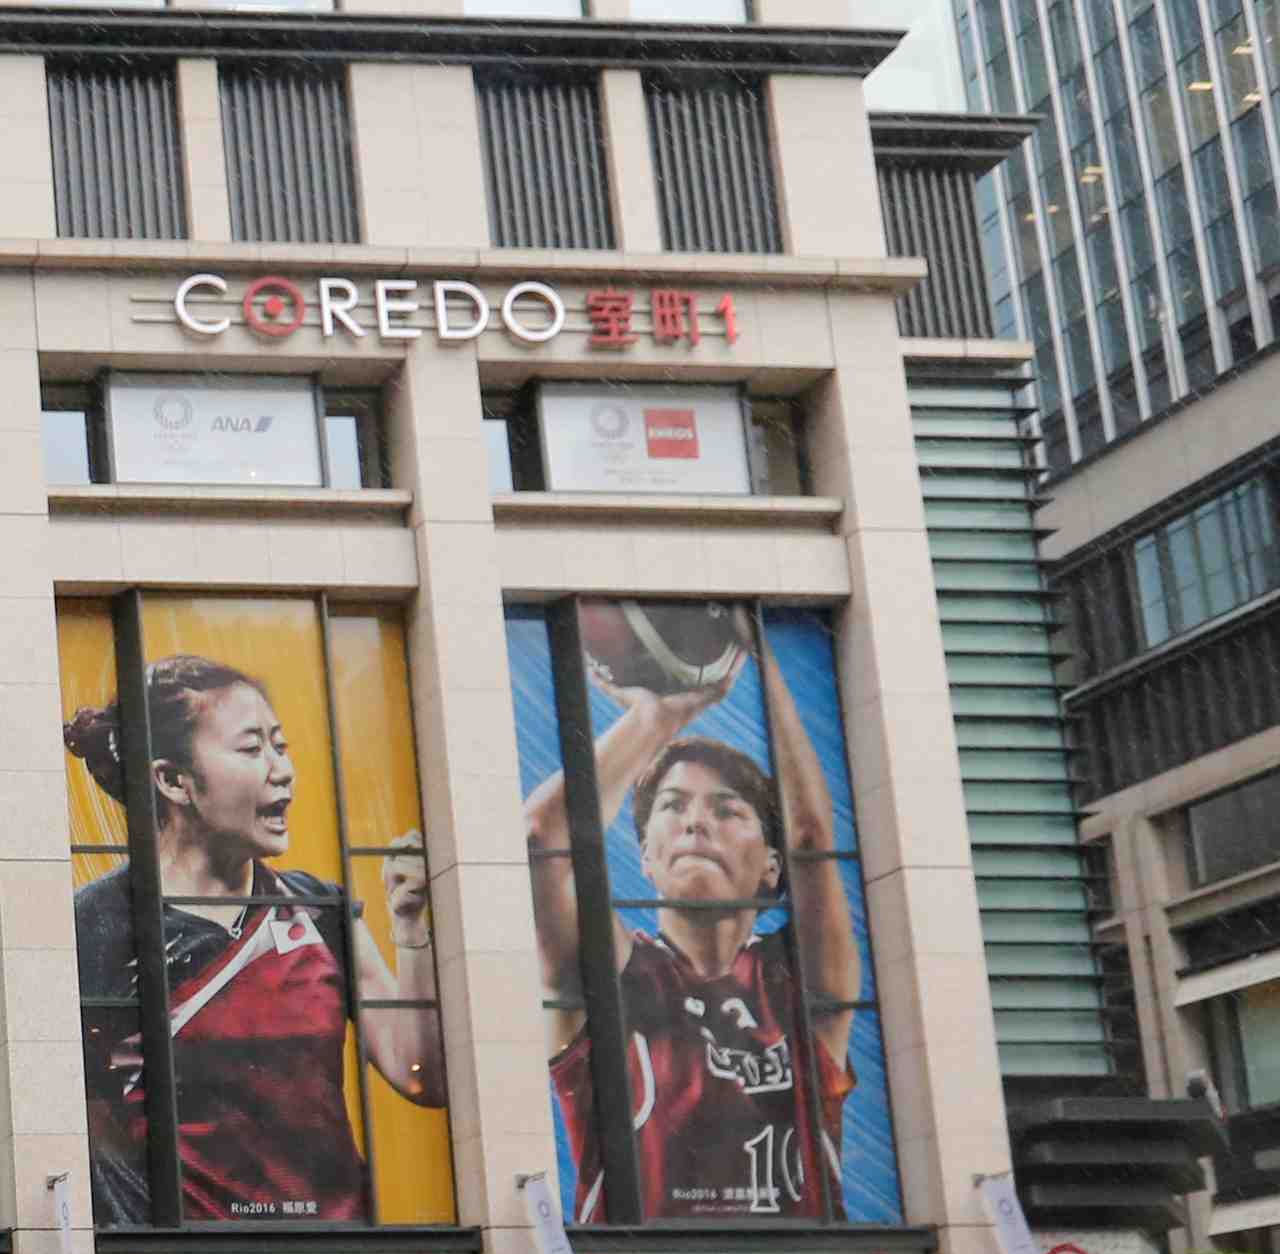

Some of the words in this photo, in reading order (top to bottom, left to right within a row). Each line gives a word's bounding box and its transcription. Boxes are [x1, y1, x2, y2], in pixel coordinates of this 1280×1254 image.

[174, 273, 567, 343] COREDO
[585, 287, 739, 351] 室町1
[210, 415, 253, 432] ANA
[231, 1202, 276, 1213] Rio2016
